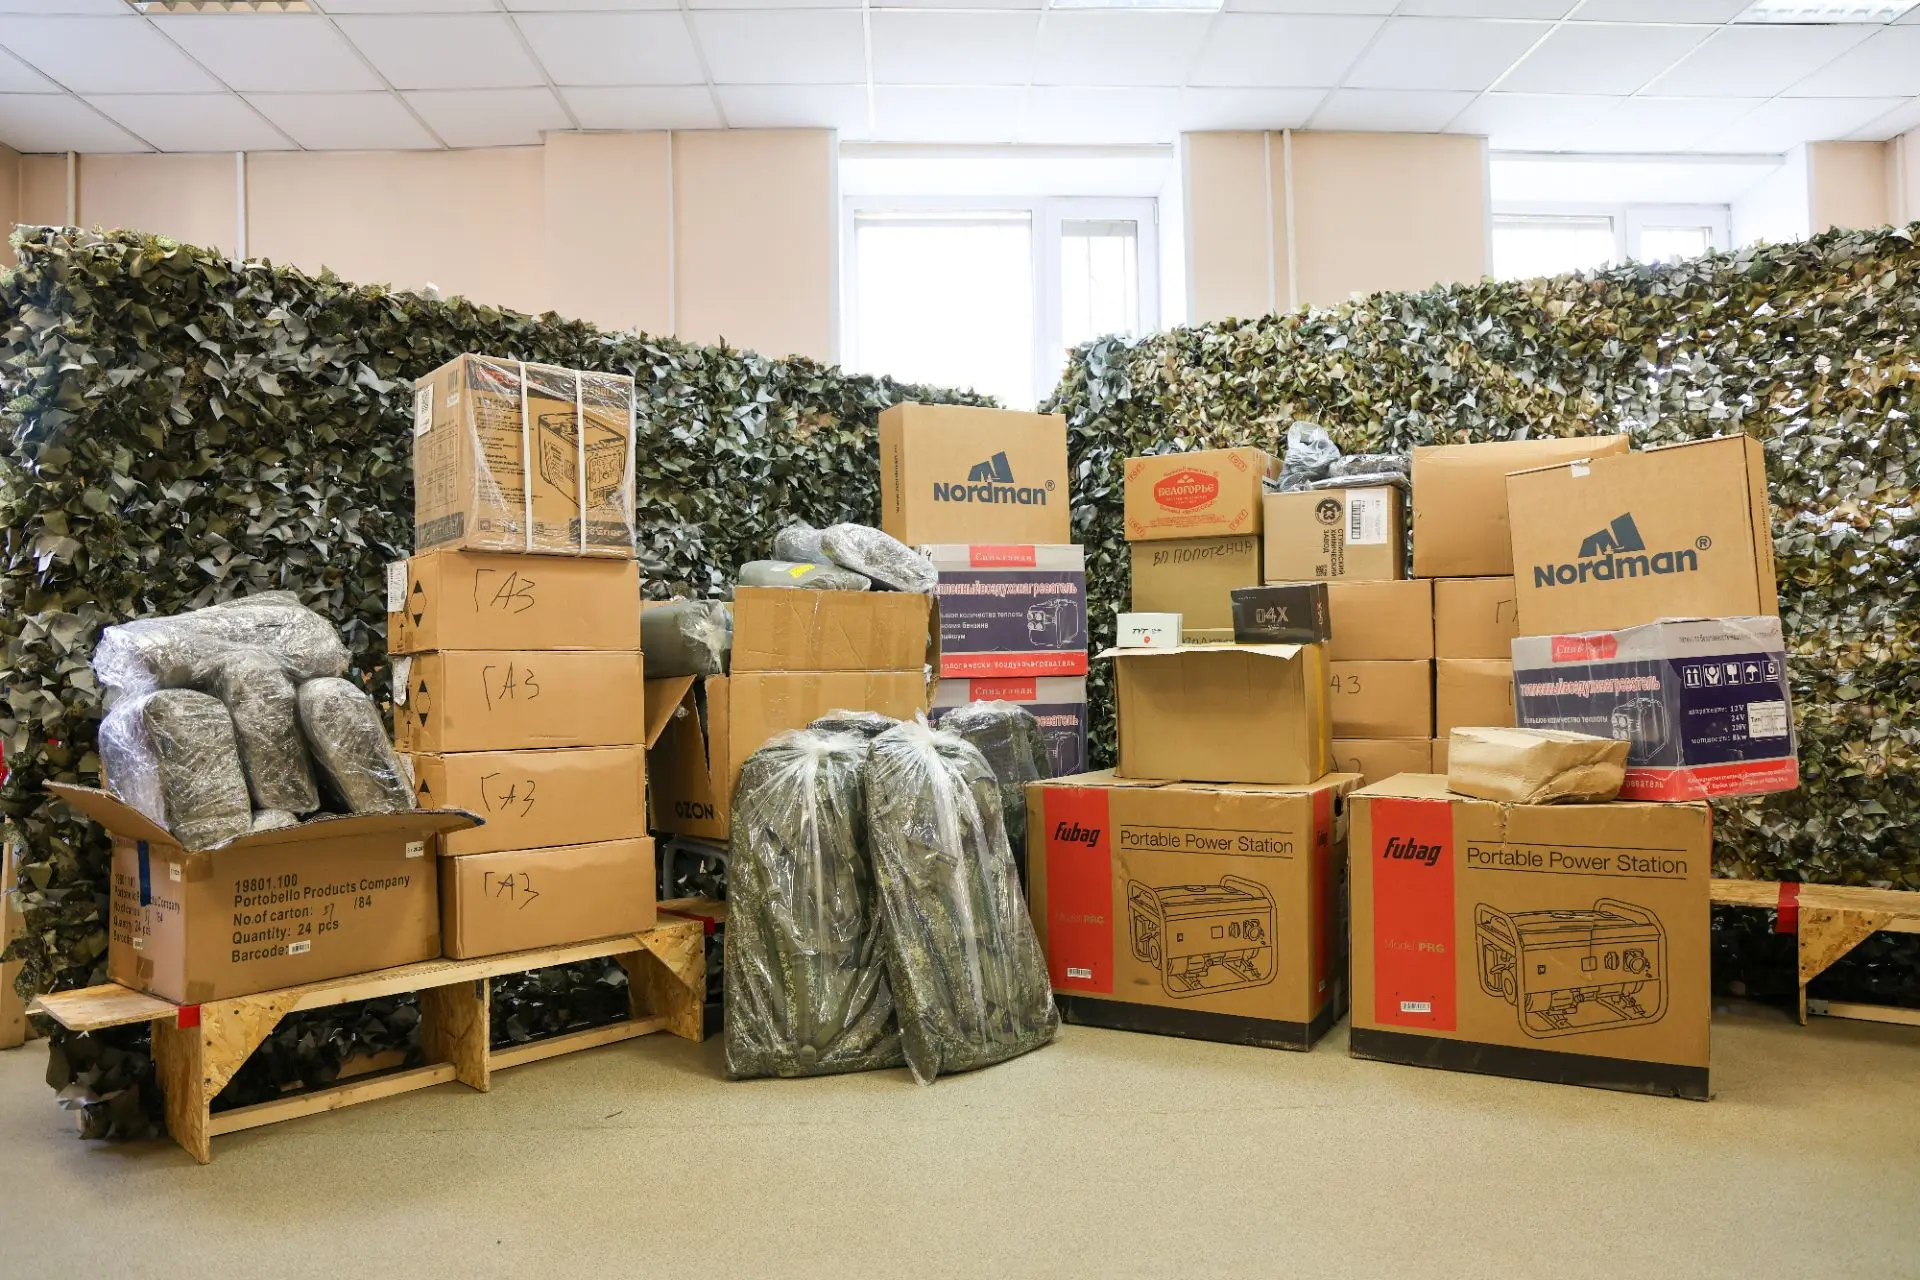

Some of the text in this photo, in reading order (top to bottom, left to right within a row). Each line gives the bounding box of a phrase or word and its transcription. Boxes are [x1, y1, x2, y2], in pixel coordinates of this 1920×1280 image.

[1158, 483, 1215, 496] БЕЛОГОРЬЕ
[675, 802, 714, 819] OZON
[1053, 821, 1102, 848] Fubag
[1120, 829, 1293, 854] Portable Power Station
[1382, 836, 1442, 867] Fubag
[1467, 847, 1688, 874] Portable Power Station
[234, 875, 410, 908] Portobello Products Company
[235, 873, 298, 893] 19801.100
[232, 920, 340, 944] Quantity: 24 pcs
[232, 944, 289, 963] Barcode:
